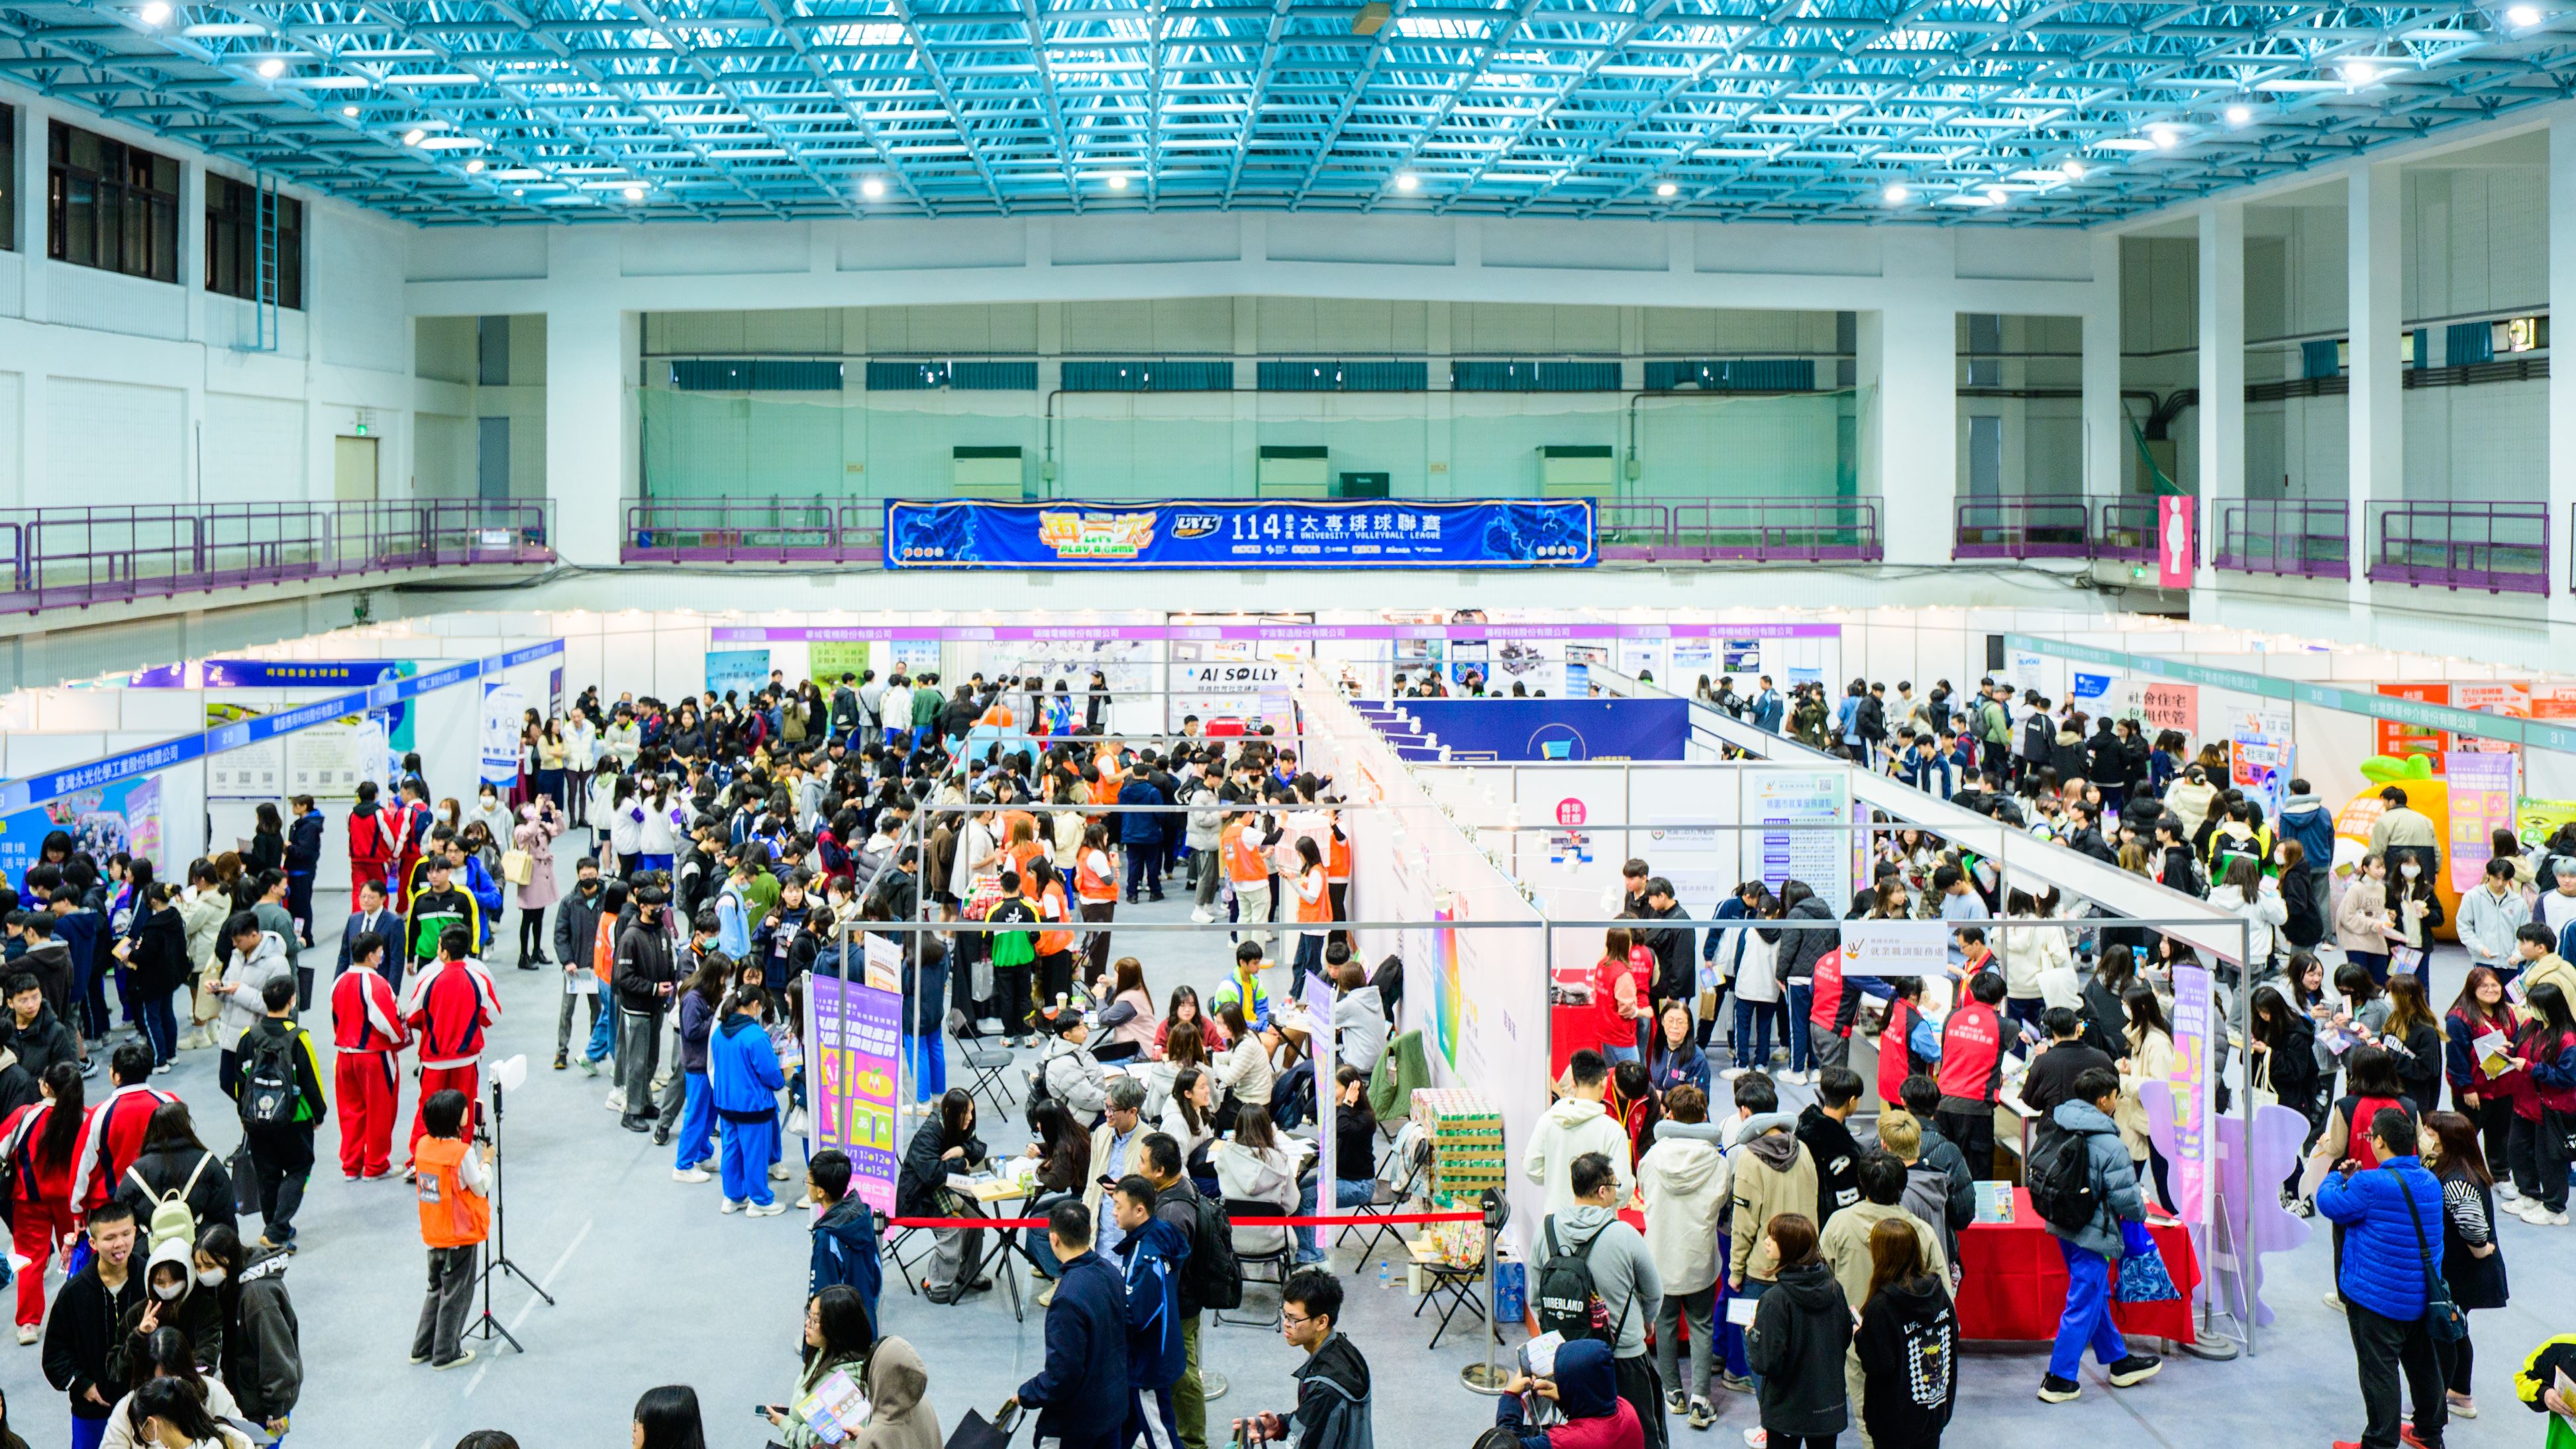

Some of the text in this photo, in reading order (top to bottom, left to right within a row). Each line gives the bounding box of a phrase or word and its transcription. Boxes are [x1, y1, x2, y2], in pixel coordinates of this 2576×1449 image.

[1232, 514, 1281, 540] 114
[1300, 514, 1441, 532] 大專排球聯賽
[1084, 535, 1111, 544] Let's
[1060, 544, 1135, 554] PLAY A GAME
[806, 630, 892, 639] 華城電機股份有限公司
[1200, 668, 1278, 681] AI SOLLY
[2188, 670, 2258, 692] 台一不動產股份有限公司
[2128, 691, 2187, 709] 社會住宅
[2311, 689, 2322, 702] 30
[2128, 707, 2186, 725] 包租代管
[2369, 700, 2477, 731] 台灣房屋仲介股份有限公司
[2551, 731, 2565, 745] 31
[55, 744, 179, 795] 臺灣永光化學工業股份有限公司
[1561, 803, 1581, 814] 青年
[1767, 799, 1833, 809] 桃園市就業服務據點
[1561, 814, 1582, 824] 就業
[1870, 946, 1944, 957] 就業職訓服務處
[857, 1116, 870, 1129] あ
[878, 1122, 888, 1134] A
[874, 1152, 885, 1164] 12
[871, 1166, 882, 1177] 15
